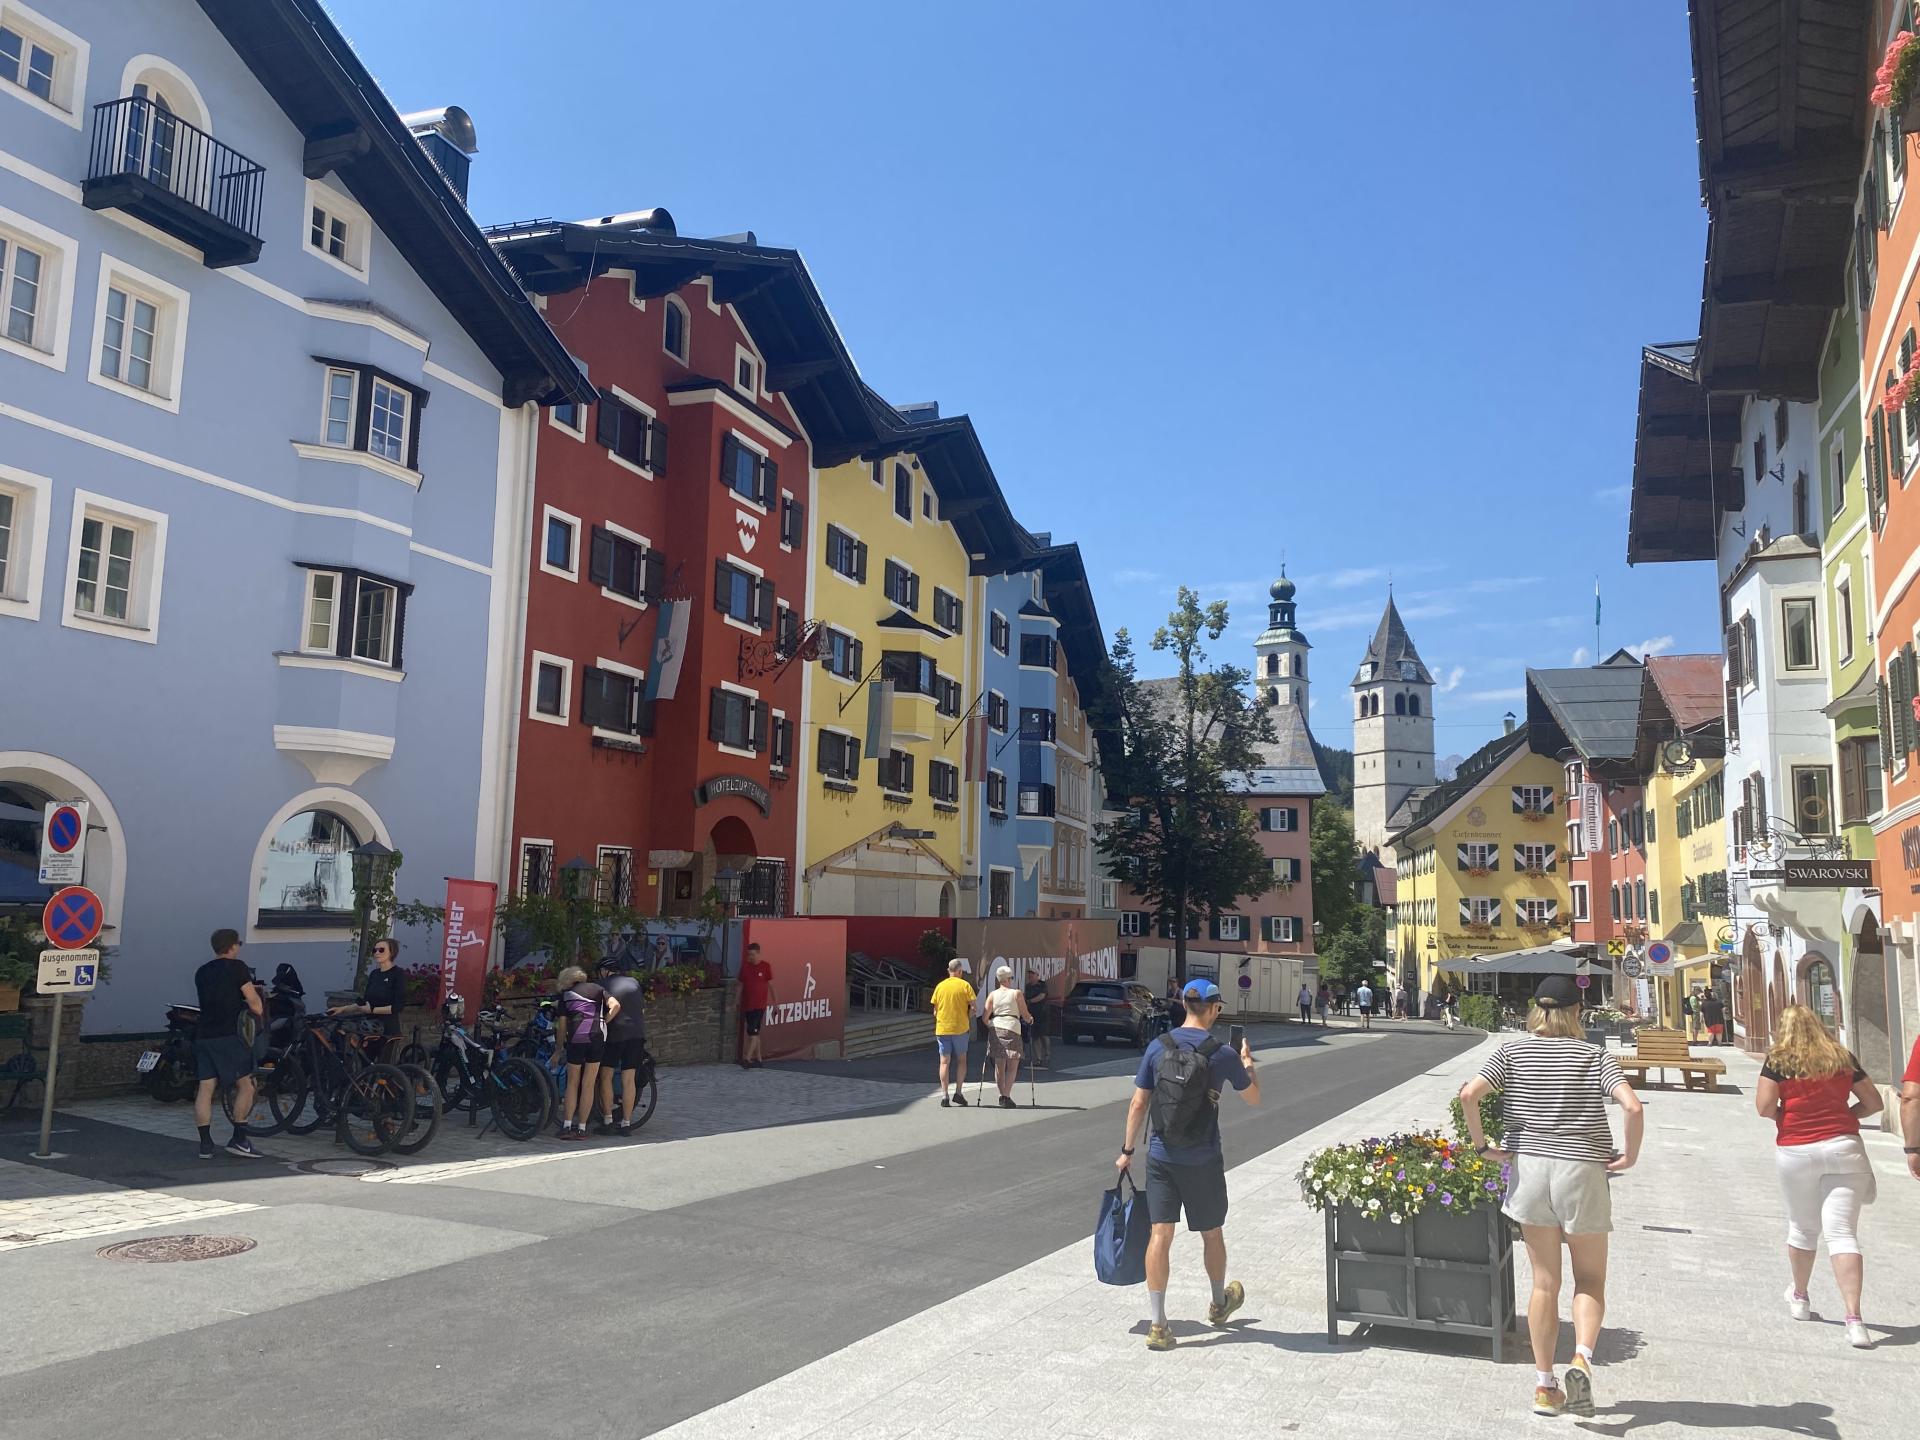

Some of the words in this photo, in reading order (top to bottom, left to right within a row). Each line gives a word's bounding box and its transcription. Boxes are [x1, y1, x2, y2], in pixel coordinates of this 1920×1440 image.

[710, 778, 734, 796] HOTEL
[735, 779, 748, 793] ZUR
[1452, 829, 1501, 839] Tiefenbrunner
[1788, 868, 1868, 879] SWAROVSKI
[42, 953, 97, 964] ausgenommen
[1097, 945, 1118, 979] NOW
[55, 967, 67, 977] 5m
[765, 998, 831, 1026] KITZBÜHEL
